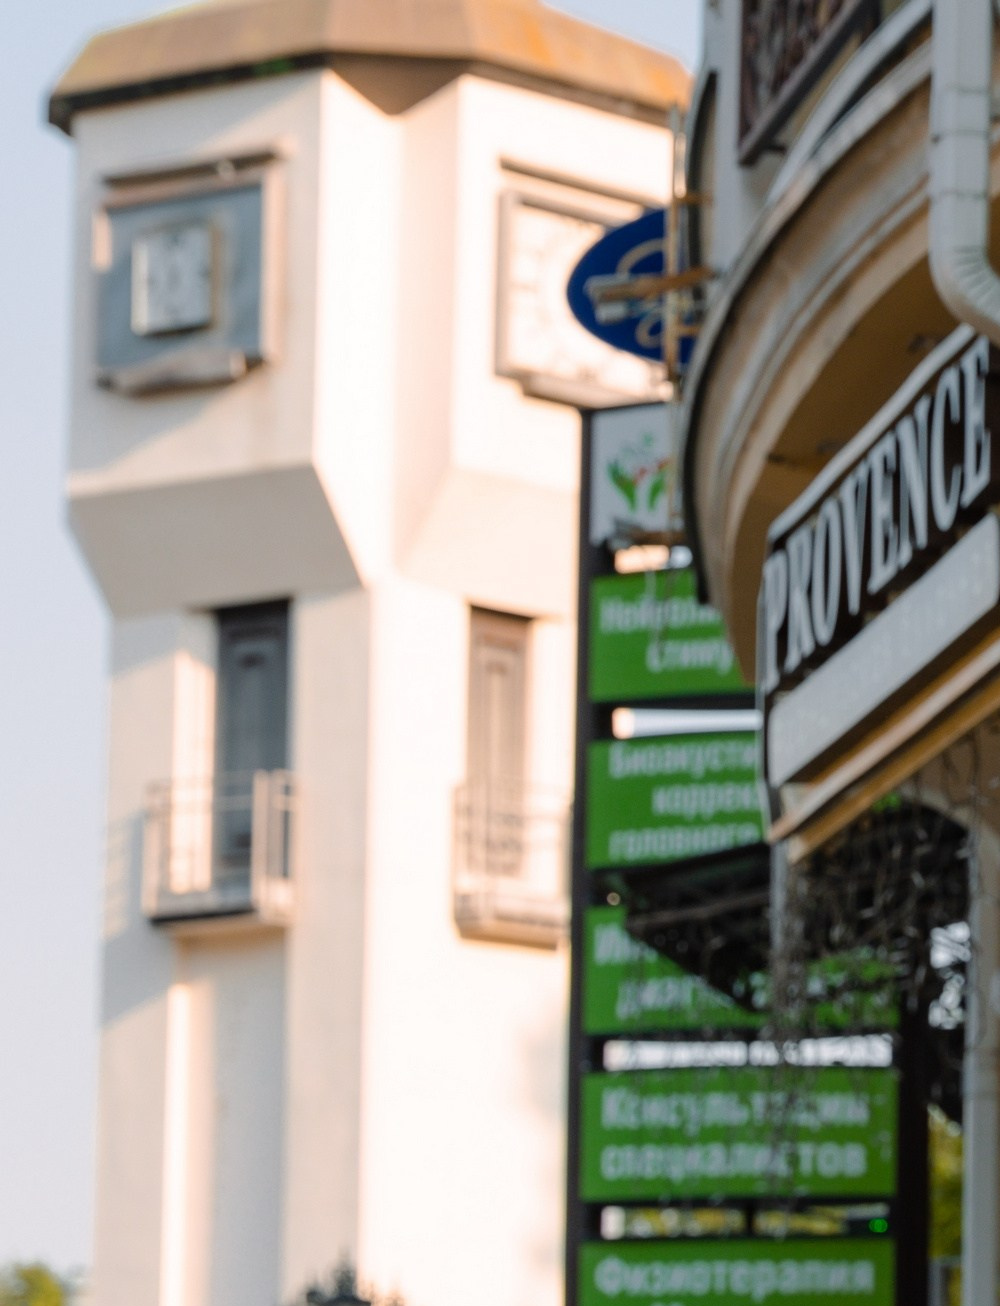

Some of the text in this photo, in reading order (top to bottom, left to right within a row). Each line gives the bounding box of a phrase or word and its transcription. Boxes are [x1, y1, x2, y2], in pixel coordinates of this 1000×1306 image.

[763, 335, 992, 695] PROVENCE
[600, 1142, 867, 1183] специалистов
[594, 1256, 875, 1302] Физиотерапия
